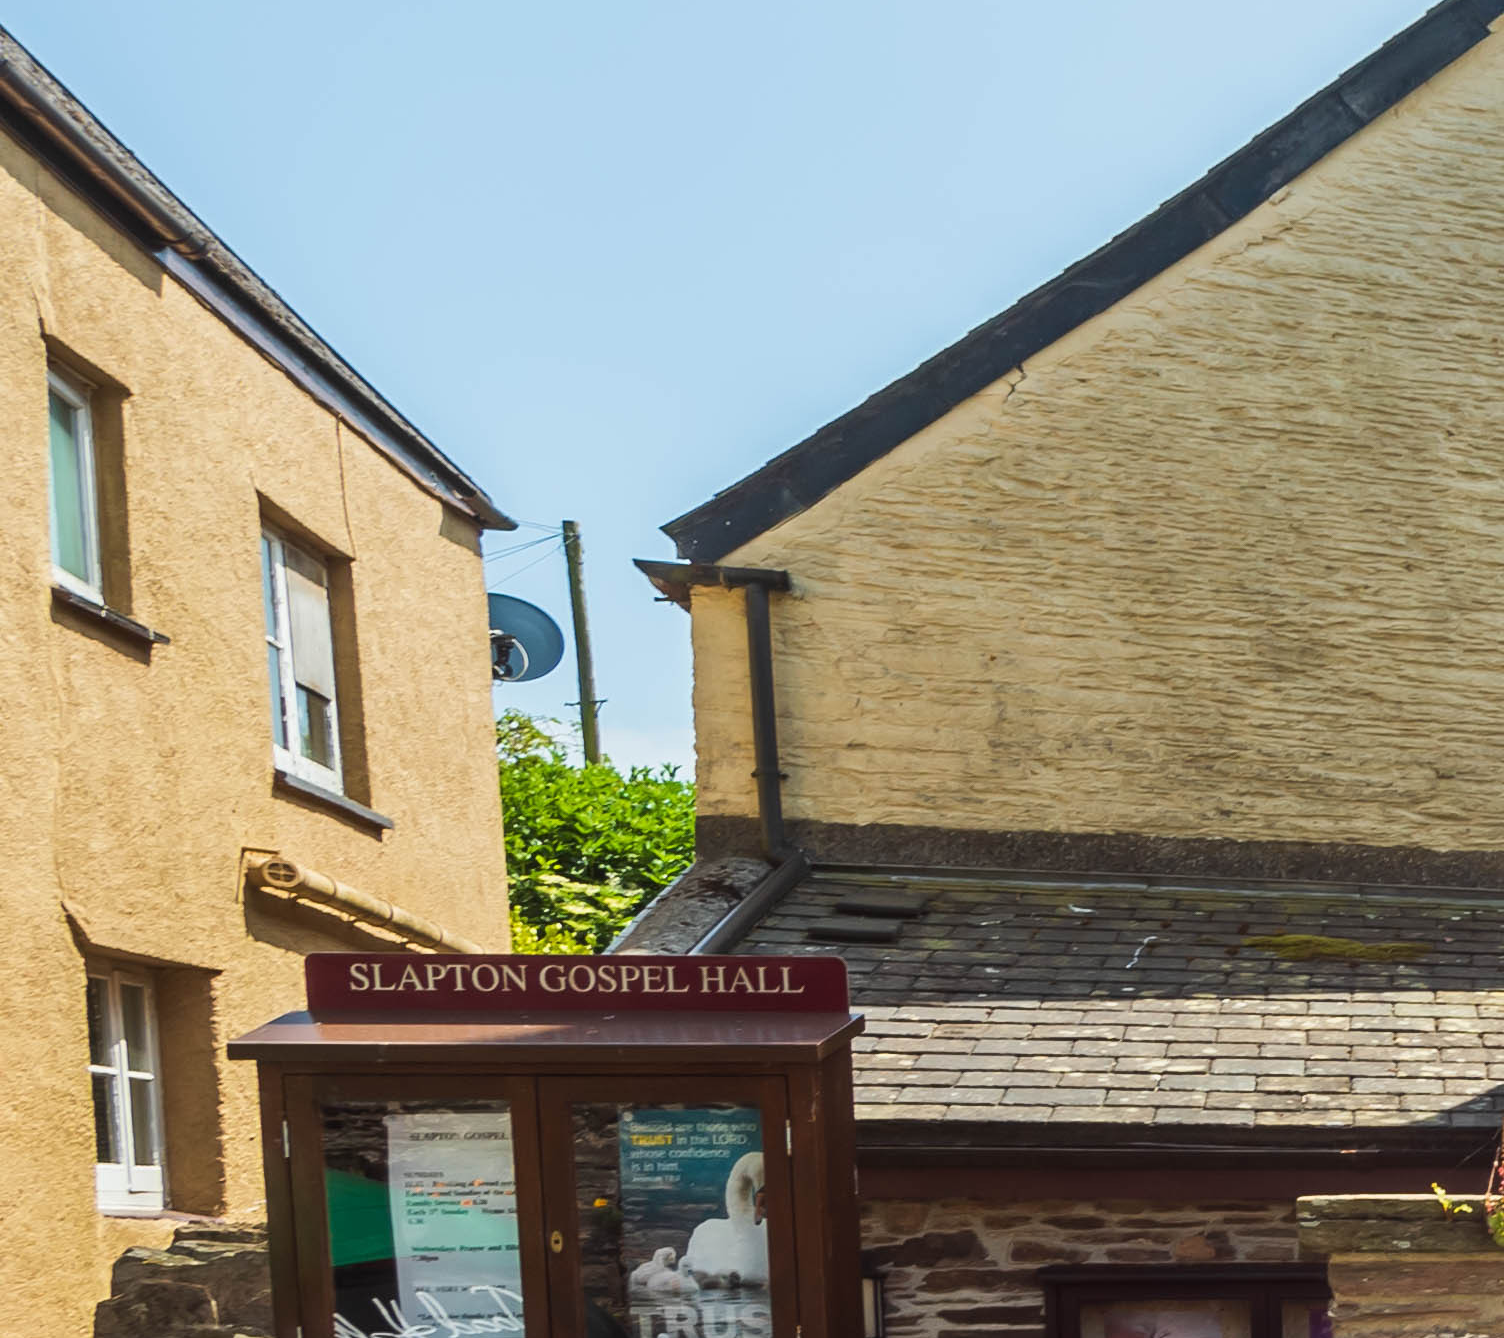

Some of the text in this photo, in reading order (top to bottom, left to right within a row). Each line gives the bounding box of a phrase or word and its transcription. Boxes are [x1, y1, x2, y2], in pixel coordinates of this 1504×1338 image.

[349, 963, 805, 994] SLAPTON GOSPEL HALL
[631, 1134, 673, 1145] TRUST
[668, 1148, 731, 1158] confidence
